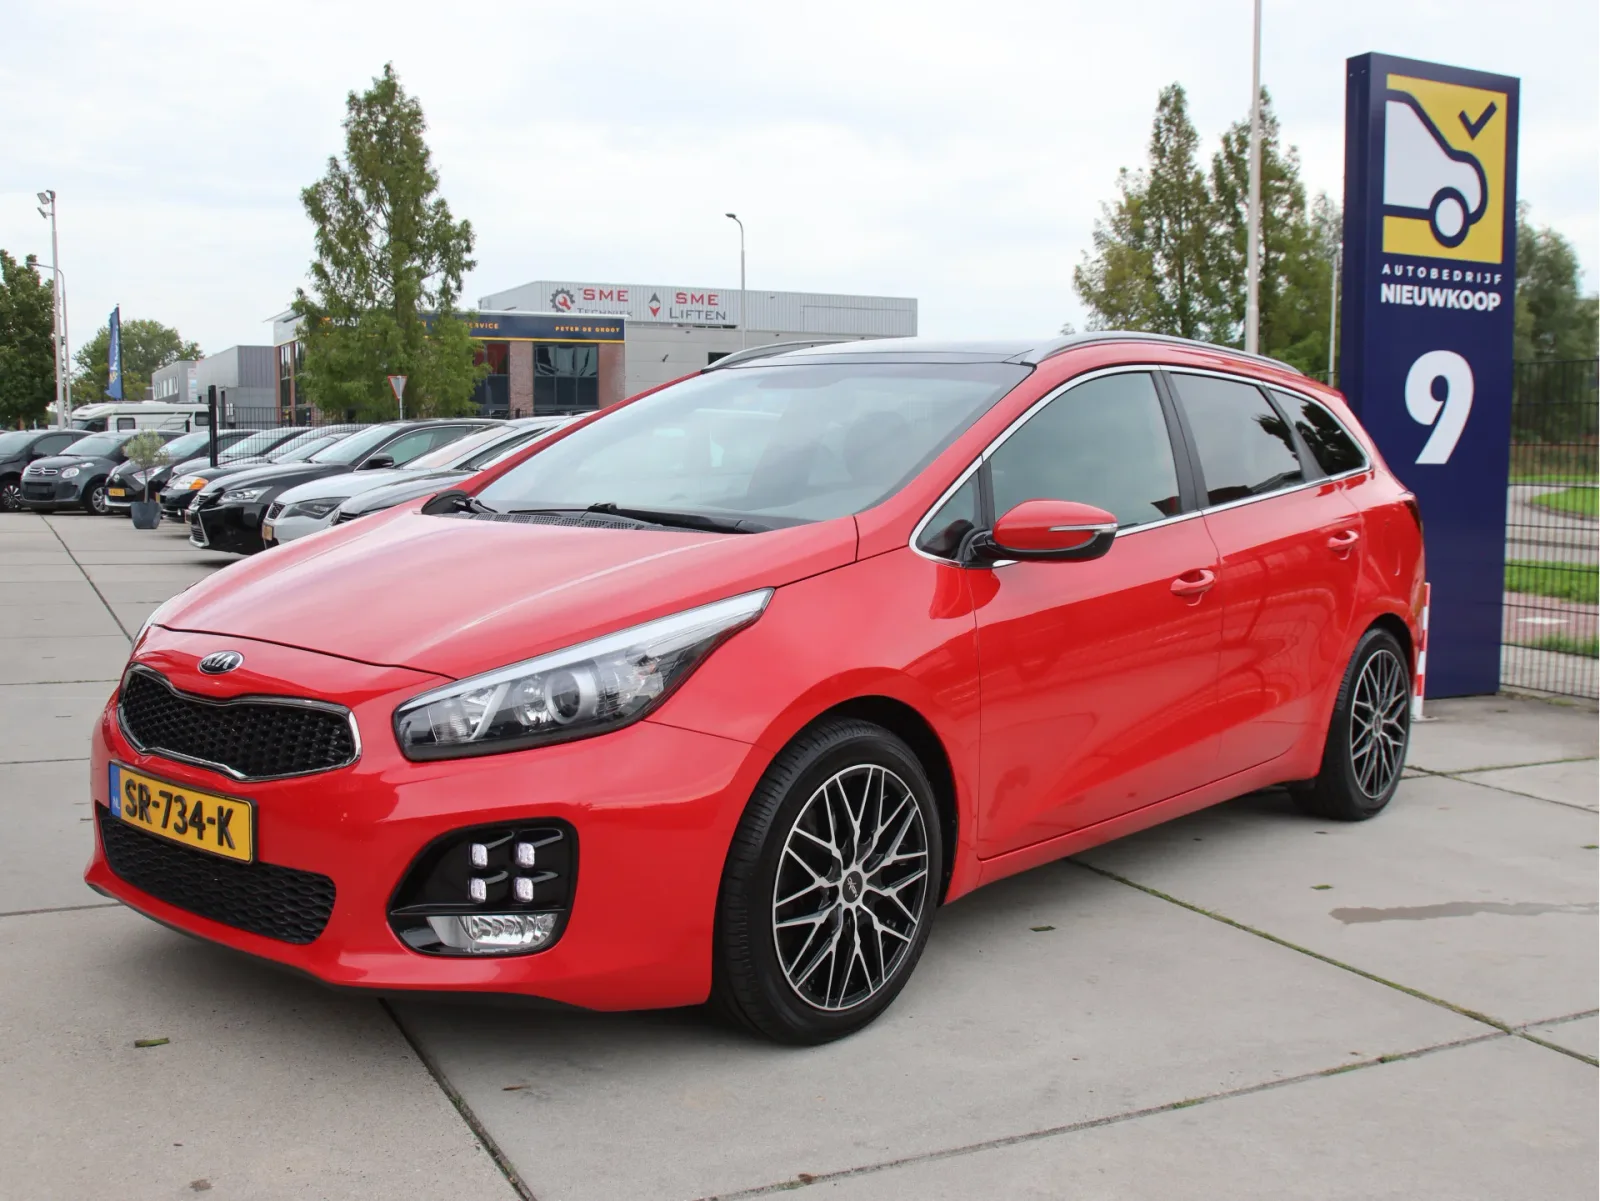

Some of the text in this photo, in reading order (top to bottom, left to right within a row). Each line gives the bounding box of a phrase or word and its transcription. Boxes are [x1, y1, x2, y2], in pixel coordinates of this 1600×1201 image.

[1381, 263, 1502, 285] AUTOBEDRIJF
[583, 288, 629, 302] SME
[675, 292, 719, 306] SME
[1380, 283, 1502, 312] NIEUWKOOP
[1404, 349, 1475, 465] 9
[202, 653, 236, 670] KIA
[124, 778, 236, 850] SR-734-K
